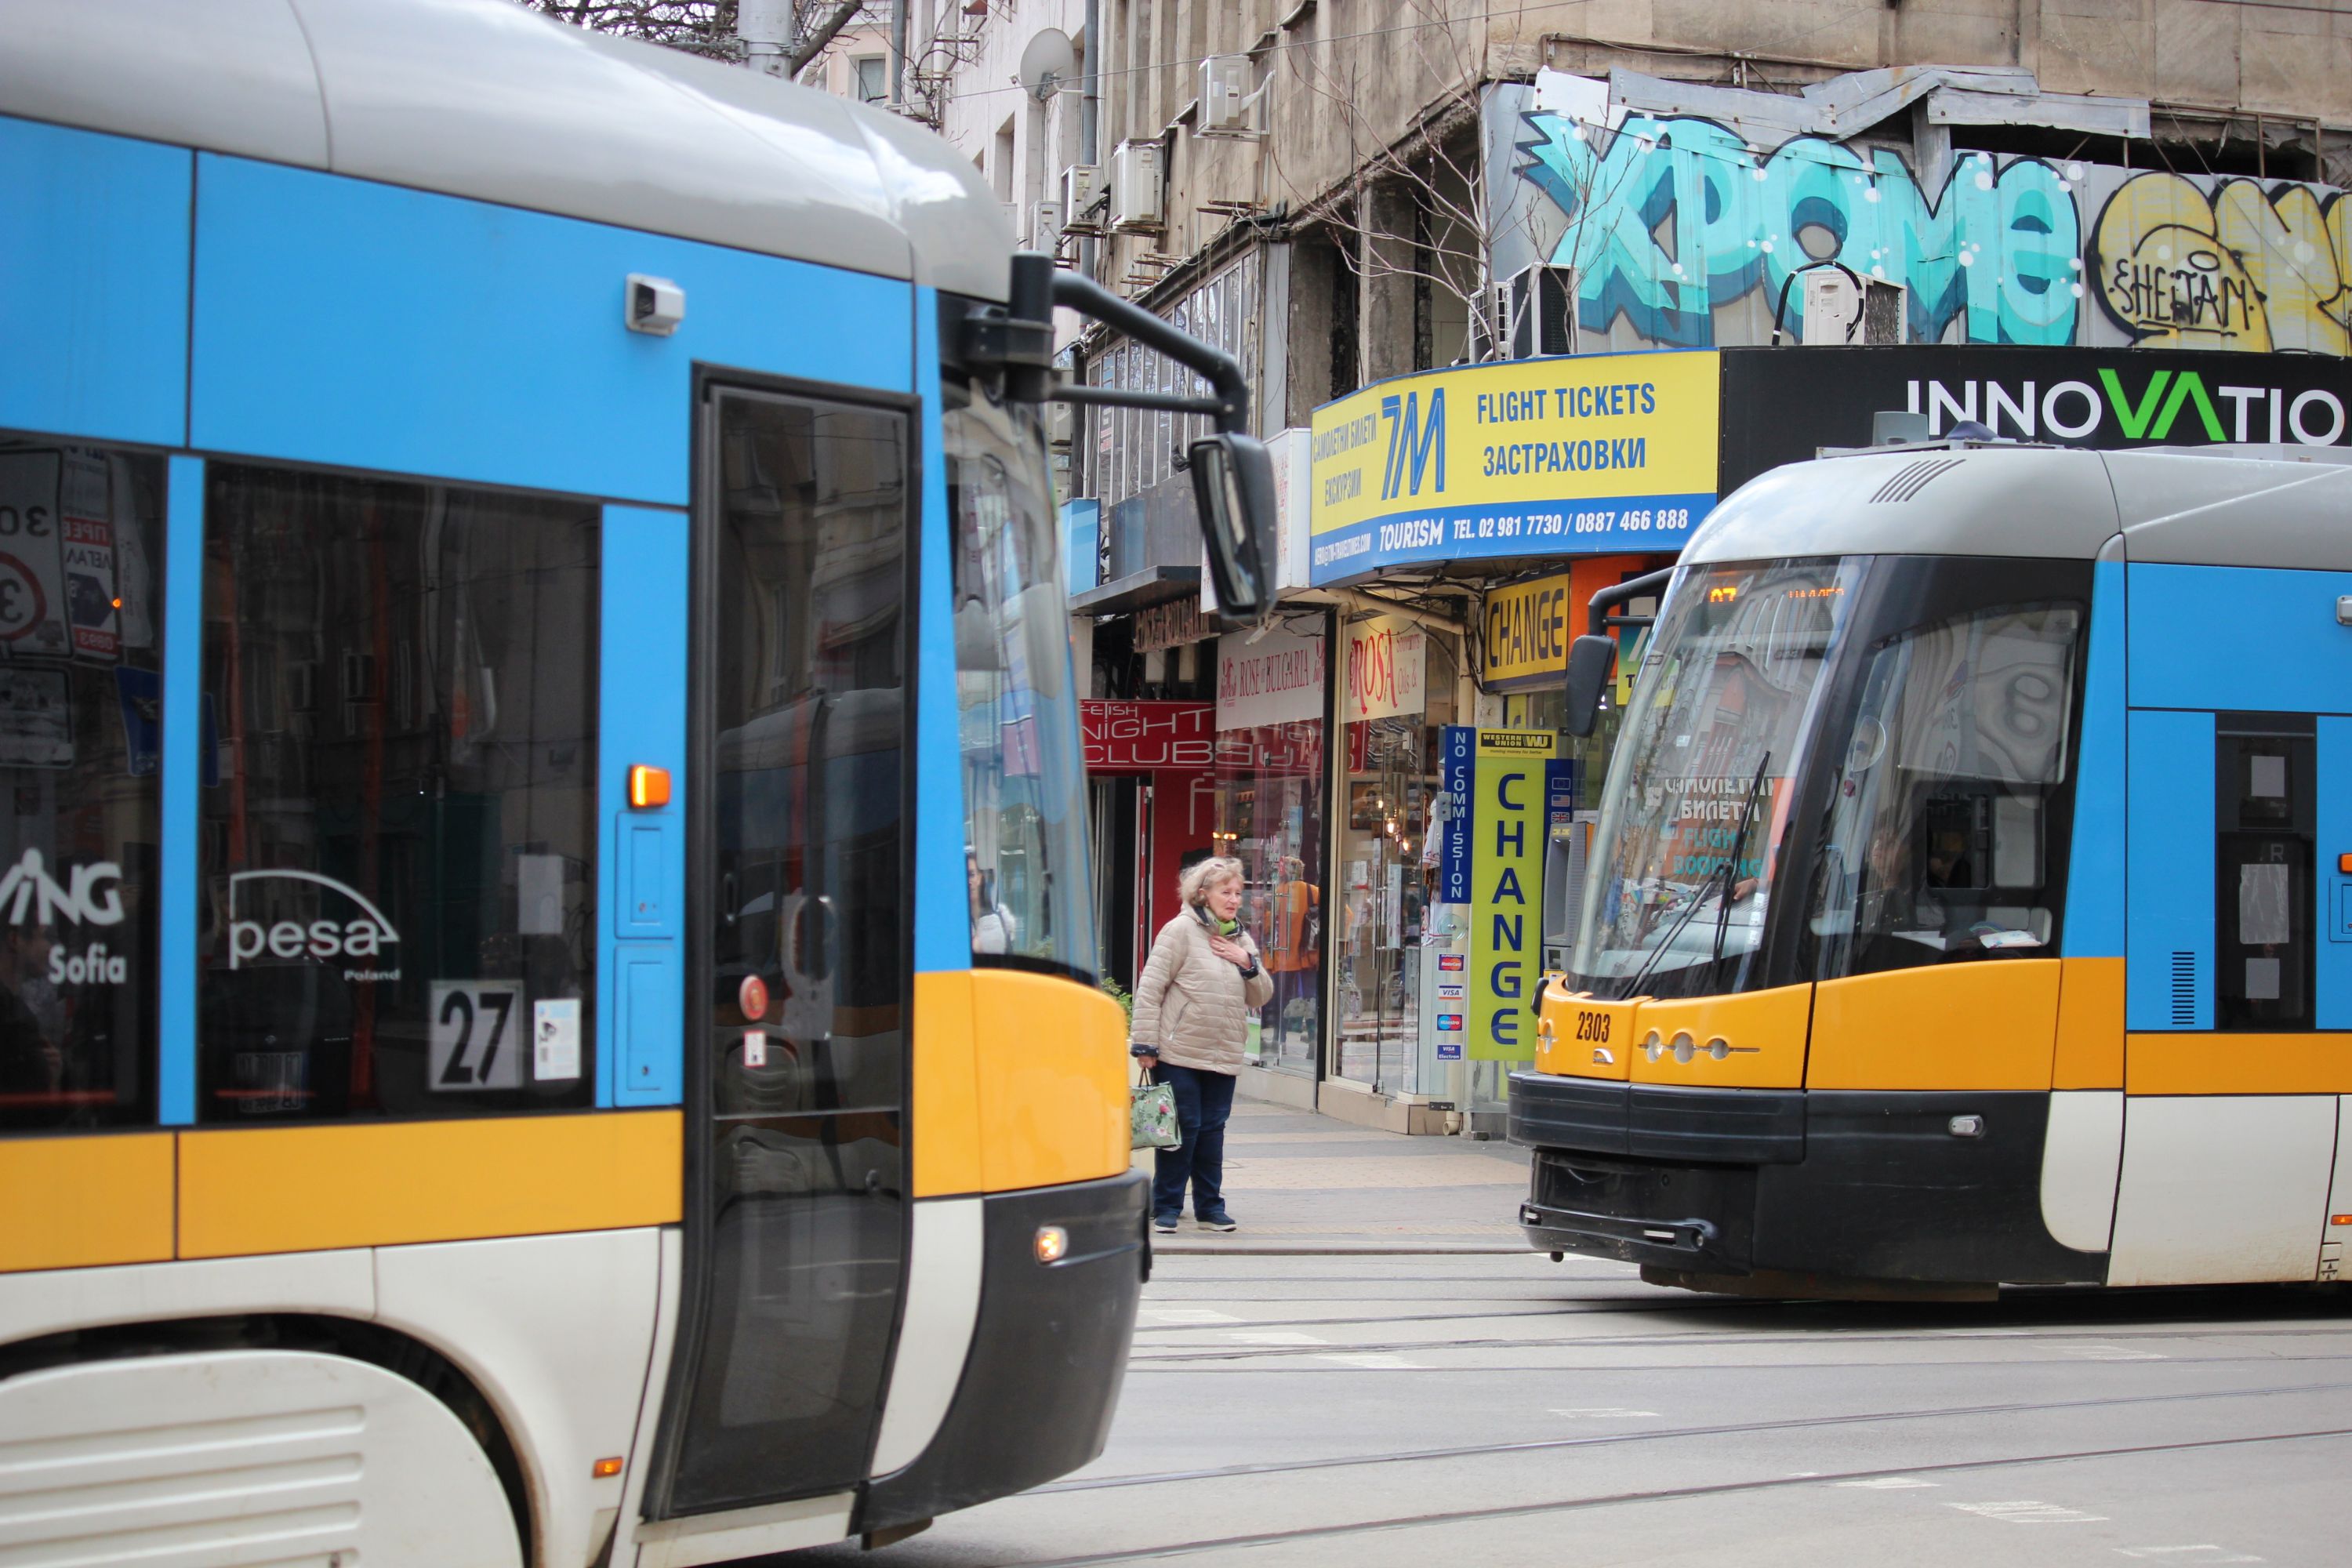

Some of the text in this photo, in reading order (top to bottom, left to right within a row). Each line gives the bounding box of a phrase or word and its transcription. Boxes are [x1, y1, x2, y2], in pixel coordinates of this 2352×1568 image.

[1478, 383, 1655, 424] FLIGHT TICKETS
[1313, 412, 1376, 463] САМОЛЕТНИ БИЛЕТИ
[1483, 437, 1646, 476] ЗАСТРАХОВКИ
[1325, 468, 1361, 506] ЕКСКУРЗИИ
[1380, 517, 1444, 552] TOURISM
[1454, 508, 1688, 539] TEL. 02 981 7730 / 0887 466 888
[1489, 586, 1564, 668] CHANGE
[1240, 658, 1260, 697] ROSE
[1265, 648, 1309, 692] BULGARIA
[1526, 735, 1548, 748] WU
[1451, 732, 1466, 898] NO COMMISSION
[1490, 773, 1526, 1045] CHANGE
[48, 943, 127, 984] Sofia
[230, 918, 379, 970] pesa
[344, 968, 401, 981] Poland
[440, 989, 514, 1085] 27
[1576, 1011, 1611, 1043] 2303
